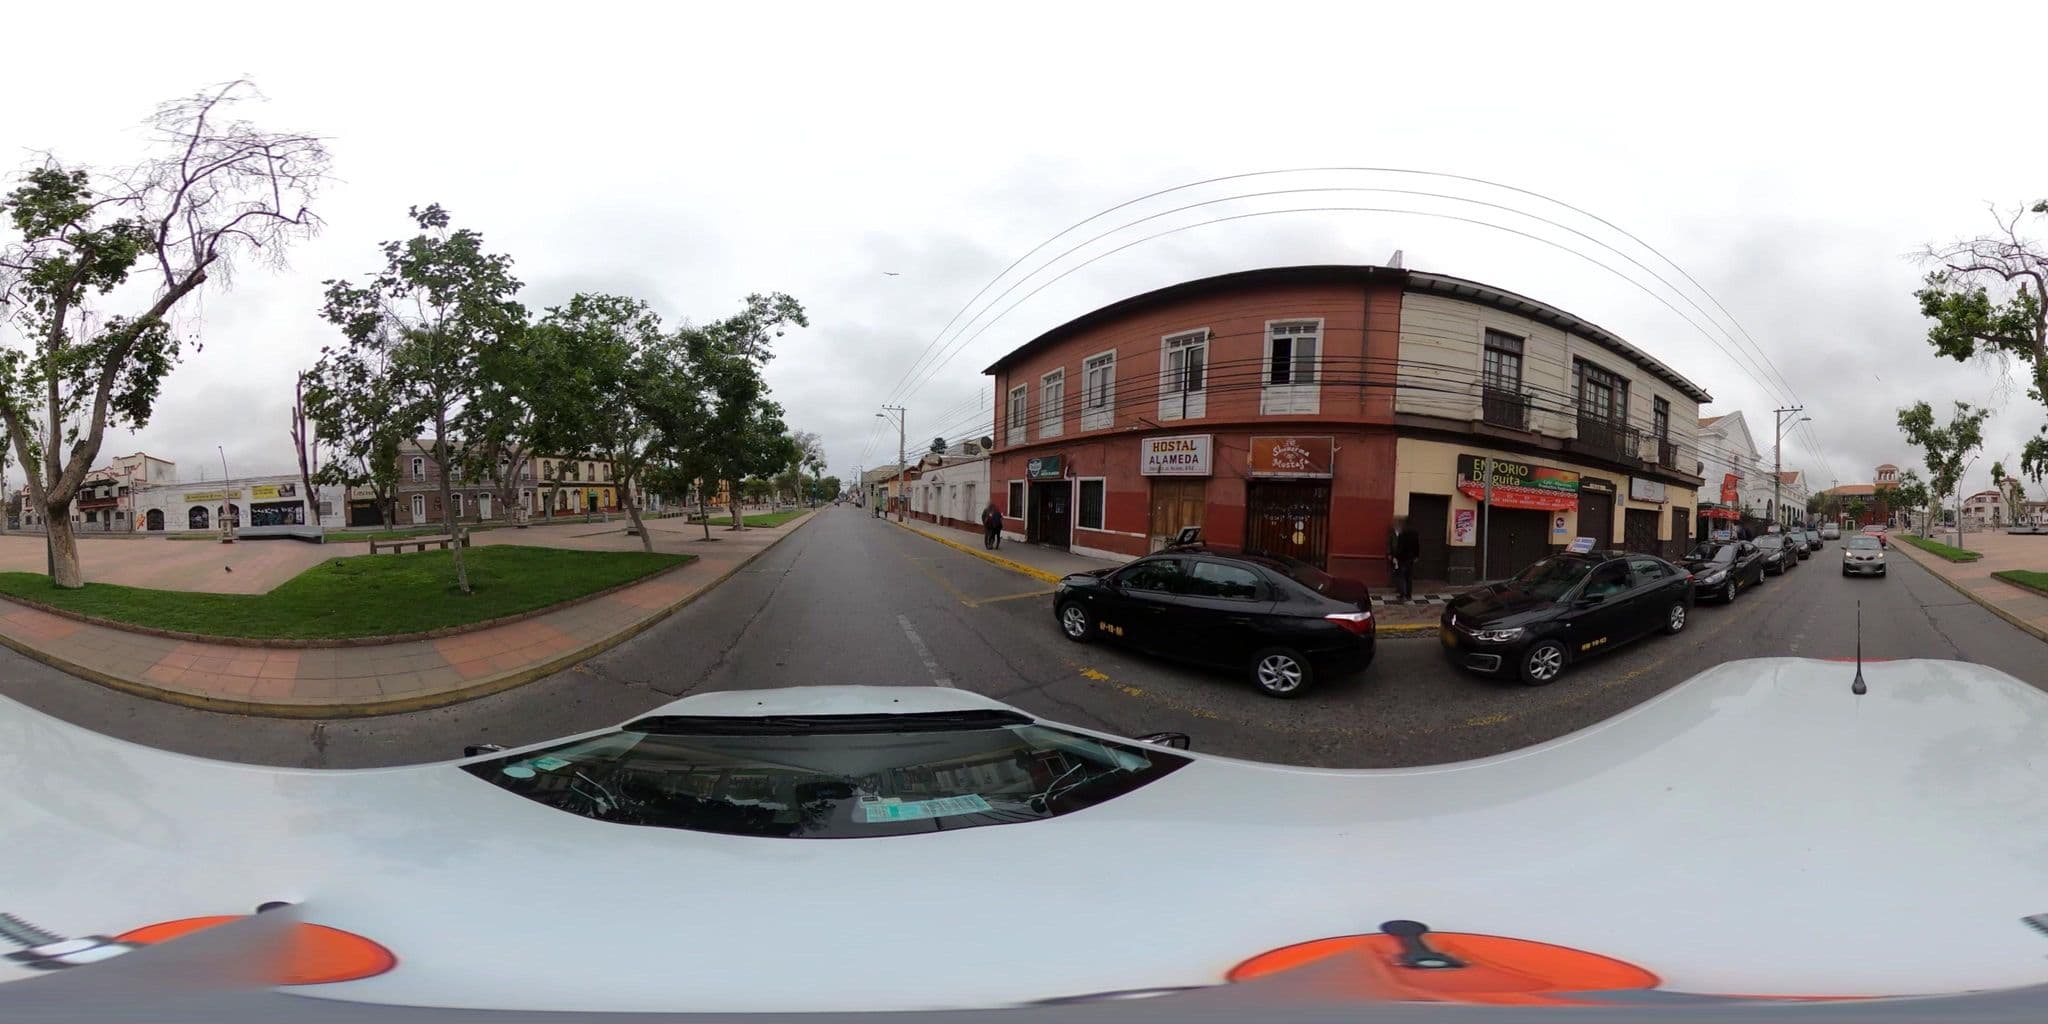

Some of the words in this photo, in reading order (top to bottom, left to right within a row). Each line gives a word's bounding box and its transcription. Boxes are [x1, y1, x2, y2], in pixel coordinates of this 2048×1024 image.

[1153, 440, 1197, 452] HOSTAL
[1149, 454, 1199, 465] ALAMEDA
[1473, 470, 1521, 487] Diguita
